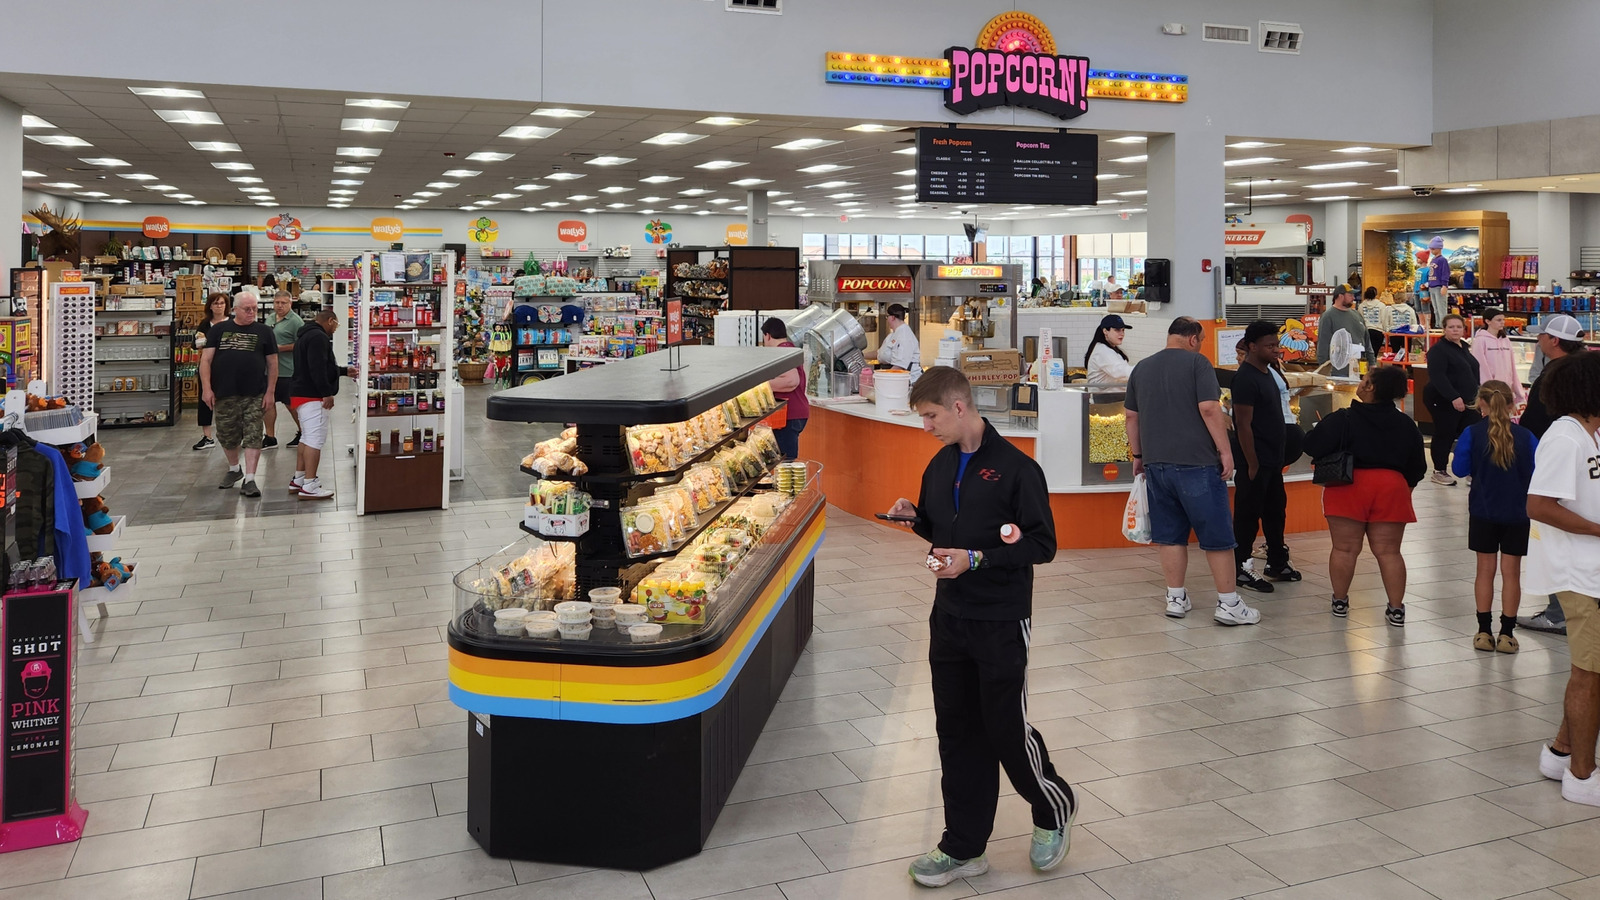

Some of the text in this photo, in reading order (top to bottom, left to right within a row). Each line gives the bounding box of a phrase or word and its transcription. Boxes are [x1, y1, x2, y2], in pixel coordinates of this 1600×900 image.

[952, 50, 1088, 111] POPCORN!
[1016, 141, 1039, 149] Popcorn
[145, 222, 168, 233] wally's
[373, 223, 401, 234] wally's
[559, 226, 585, 237] wally's
[970, 266, 994, 276] CORN
[841, 279, 907, 290] POPCORN
[12, 641, 61, 655] SHOT
[12, 699, 60, 718] PINK
[11, 716, 60, 730] WHITNEY
[11, 739, 60, 752] LEMONADE
